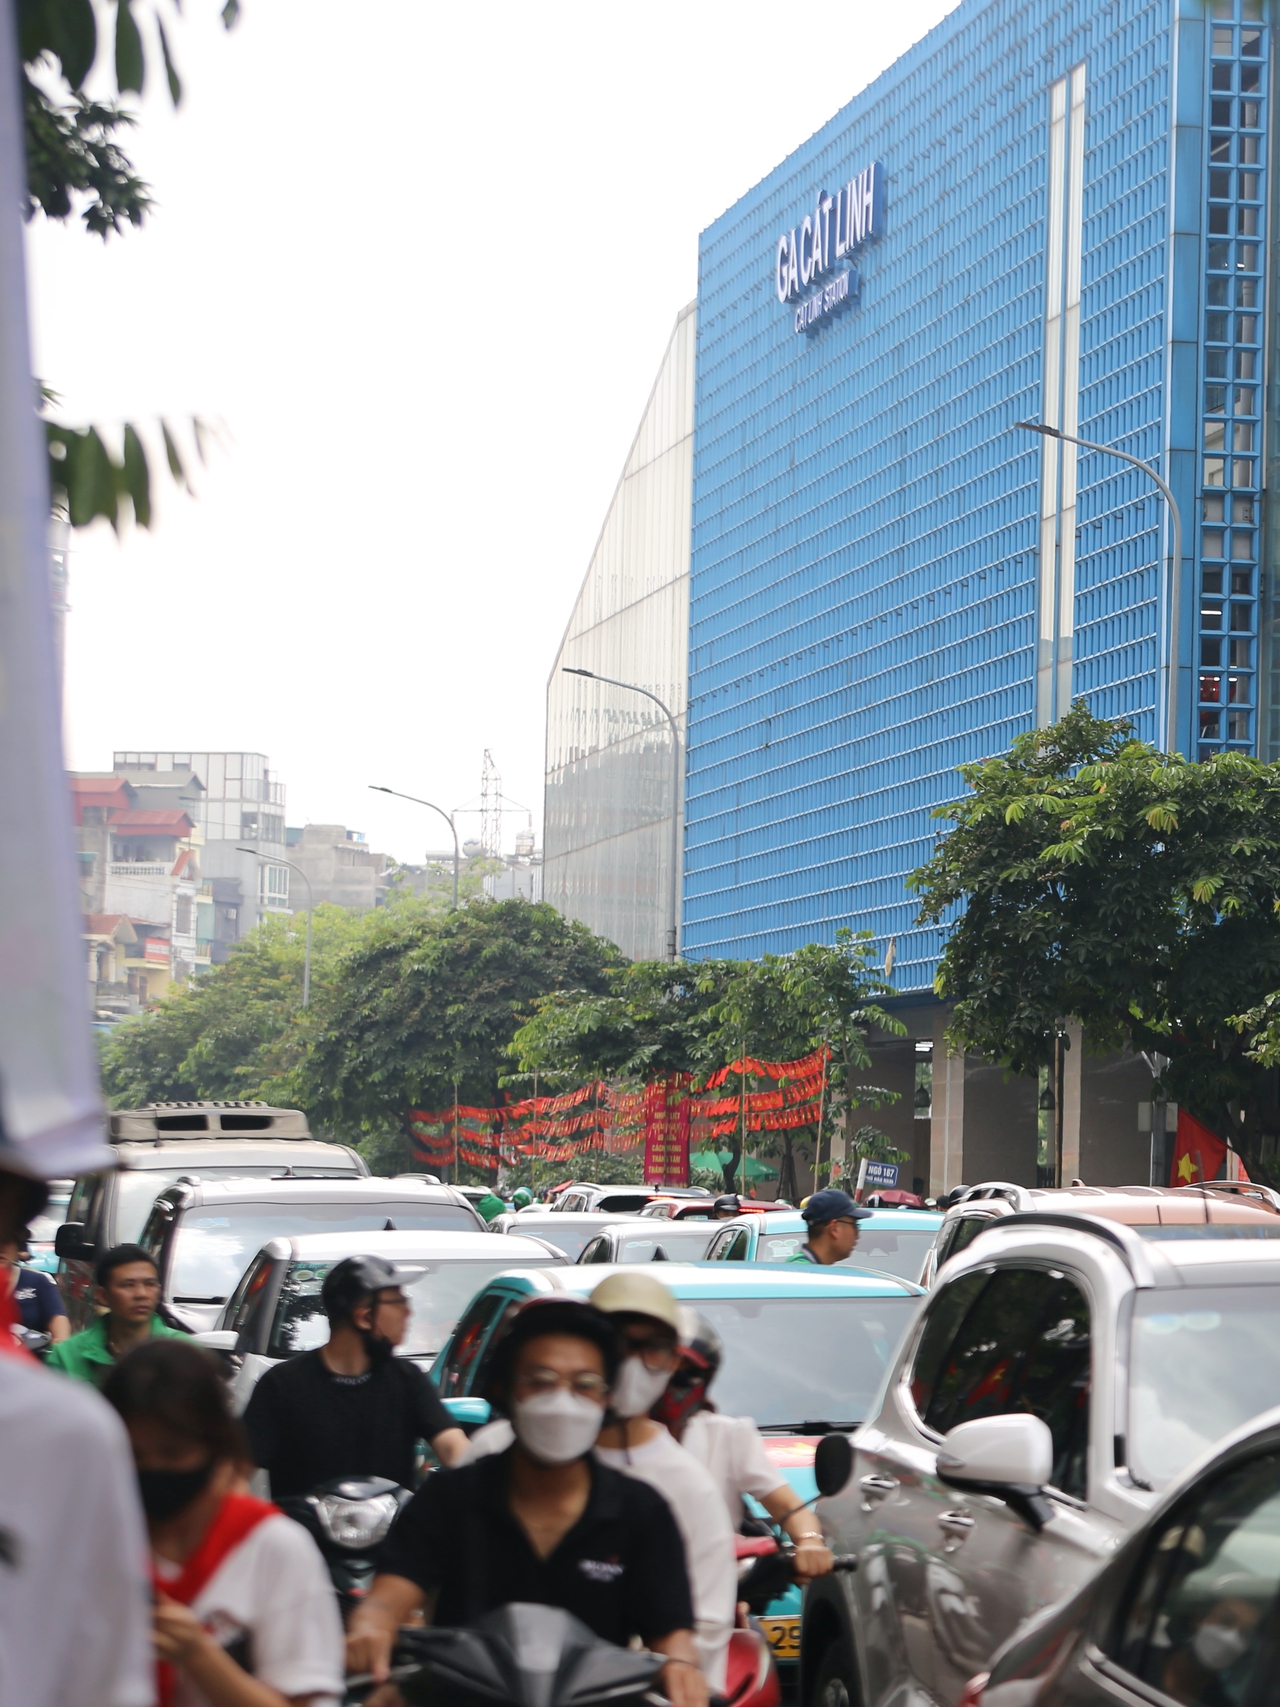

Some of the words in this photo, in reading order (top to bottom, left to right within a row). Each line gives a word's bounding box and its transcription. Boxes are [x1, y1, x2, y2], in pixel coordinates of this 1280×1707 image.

[777, 227, 800, 304] GA
[801, 189, 833, 287] CÁT
[836, 161, 876, 260] LINH
[883, 1167, 895, 1178] 167
